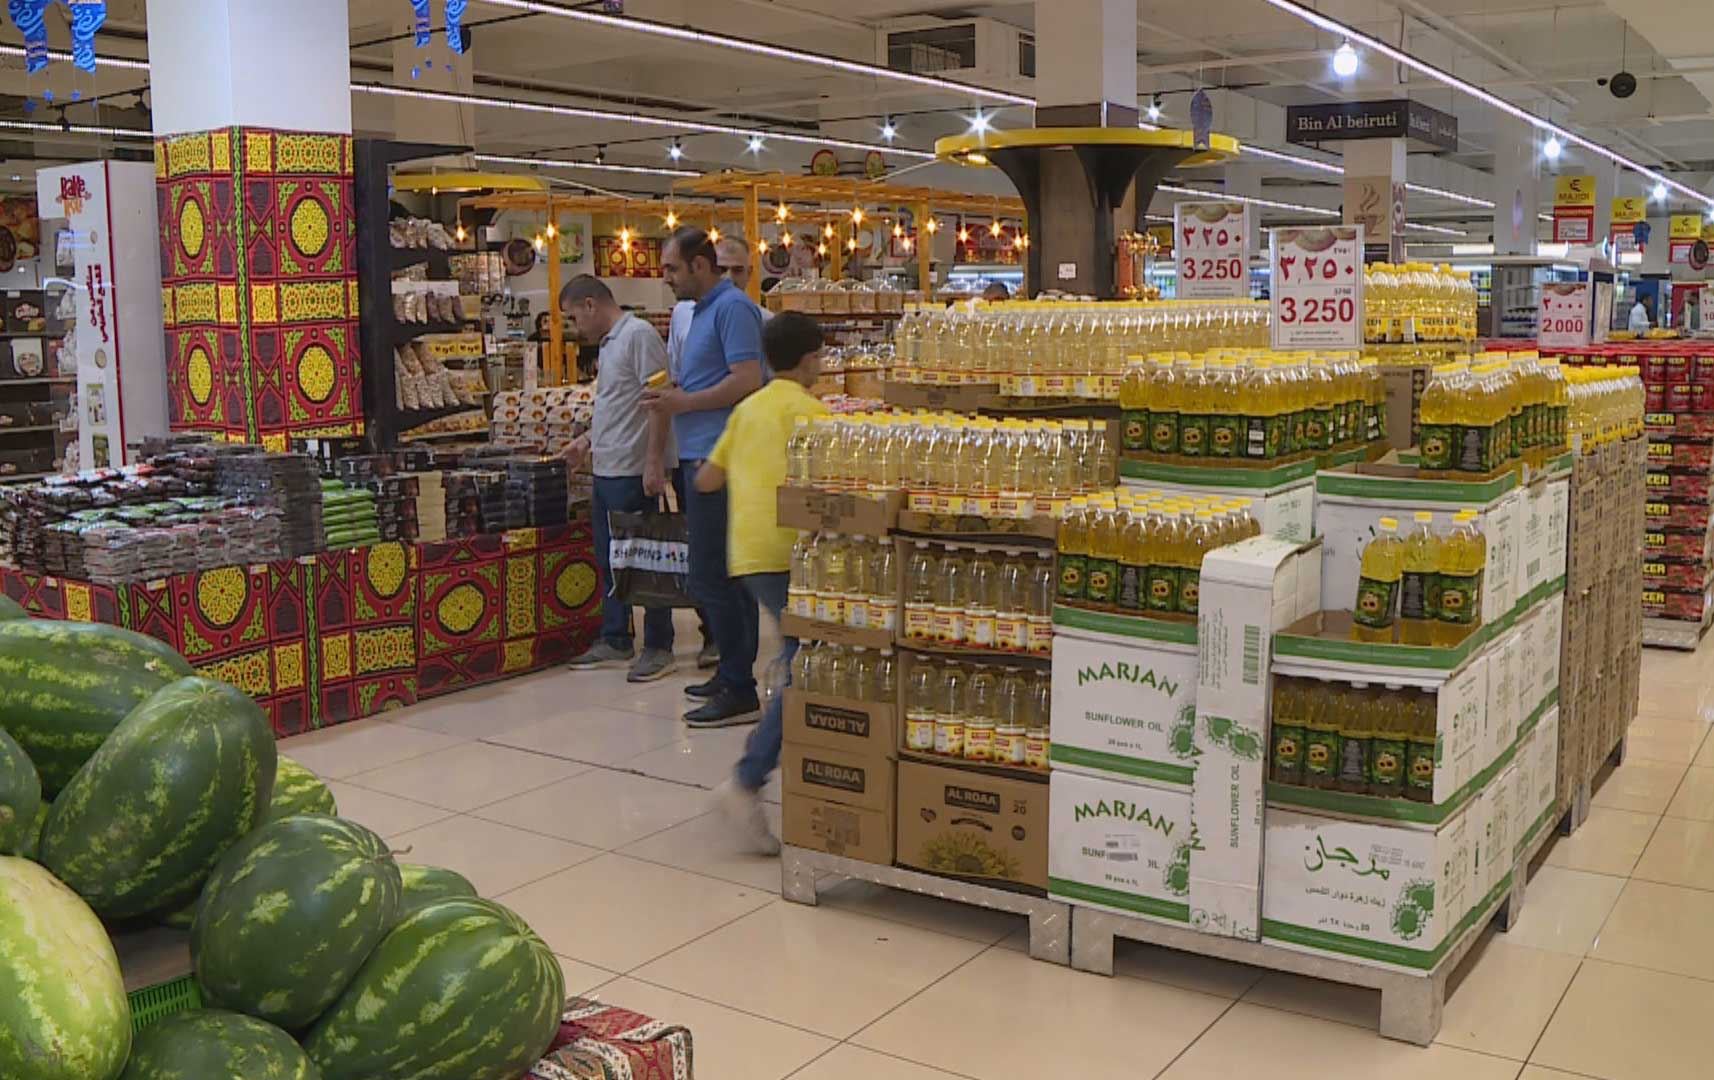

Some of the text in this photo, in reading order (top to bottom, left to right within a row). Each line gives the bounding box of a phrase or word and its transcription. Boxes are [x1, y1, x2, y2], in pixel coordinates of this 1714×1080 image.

[1298, 116, 1323, 131] Bin
[1326, 115, 1344, 130] Al
[1347, 112, 1398, 129] beiruti
[1280, 297, 1354, 325] 3,250
[1077, 661, 1179, 698] MARJAN
[809, 711, 866, 734] AL ROAA
[1085, 711, 1163, 732] SUNFLOWER OIL
[806, 761, 861, 784] AL ROAA
[947, 787, 996, 805] AL ROAA
[1013, 803, 1026, 815] 20
[1074, 799, 1175, 837] MARJAN
[1230, 784, 1240, 848] SUNFLOWER
[1303, 834, 1390, 881] مرجان
